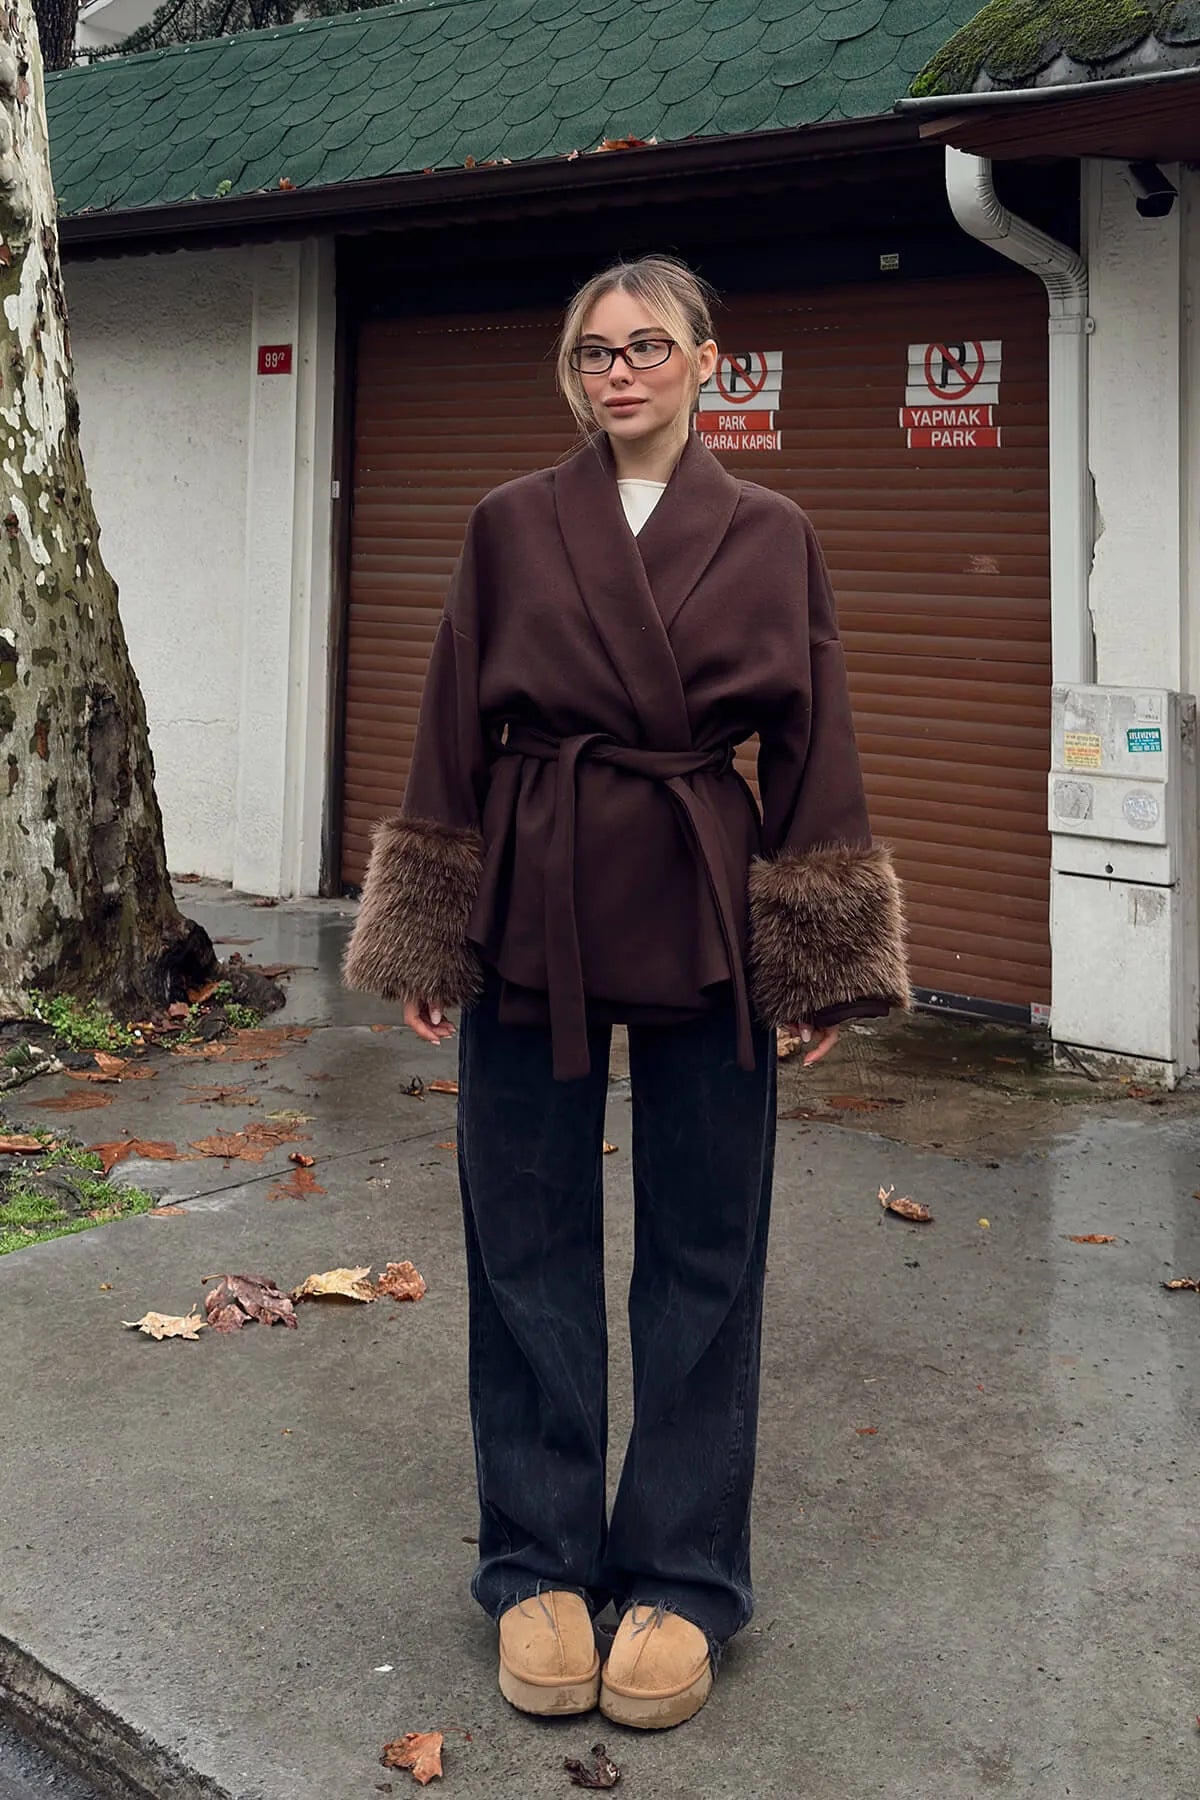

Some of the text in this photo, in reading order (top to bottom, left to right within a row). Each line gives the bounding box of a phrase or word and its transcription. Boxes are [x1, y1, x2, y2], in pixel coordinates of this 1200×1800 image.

[719, 415, 747, 430] PARK
[911, 409, 981, 426] YAPMAK
[704, 434, 776, 449] GARAJ KAPISI
[931, 430, 977, 447] PARK
